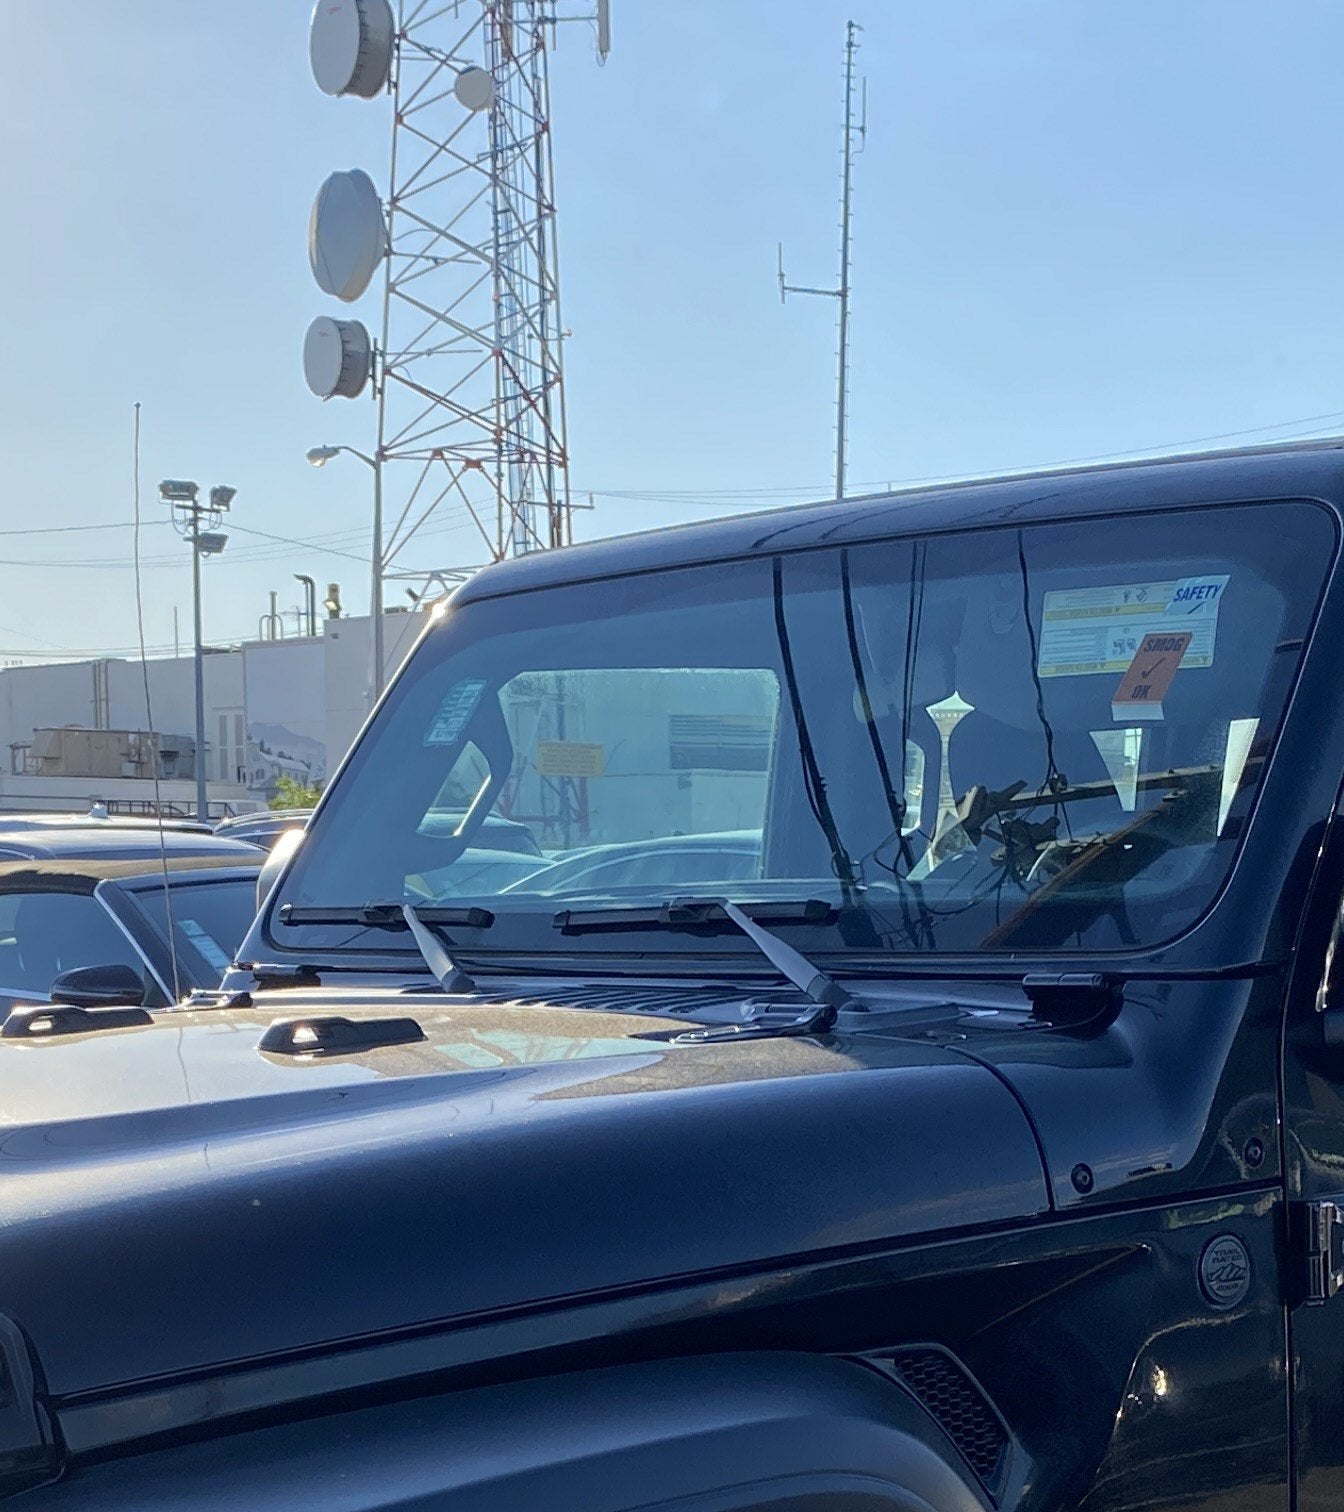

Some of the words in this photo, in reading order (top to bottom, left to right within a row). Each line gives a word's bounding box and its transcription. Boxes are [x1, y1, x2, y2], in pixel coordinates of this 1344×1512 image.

[1173, 584, 1222, 602] SAFETY
[1143, 637, 1185, 653] SMOG
[1131, 684, 1151, 699] OK
